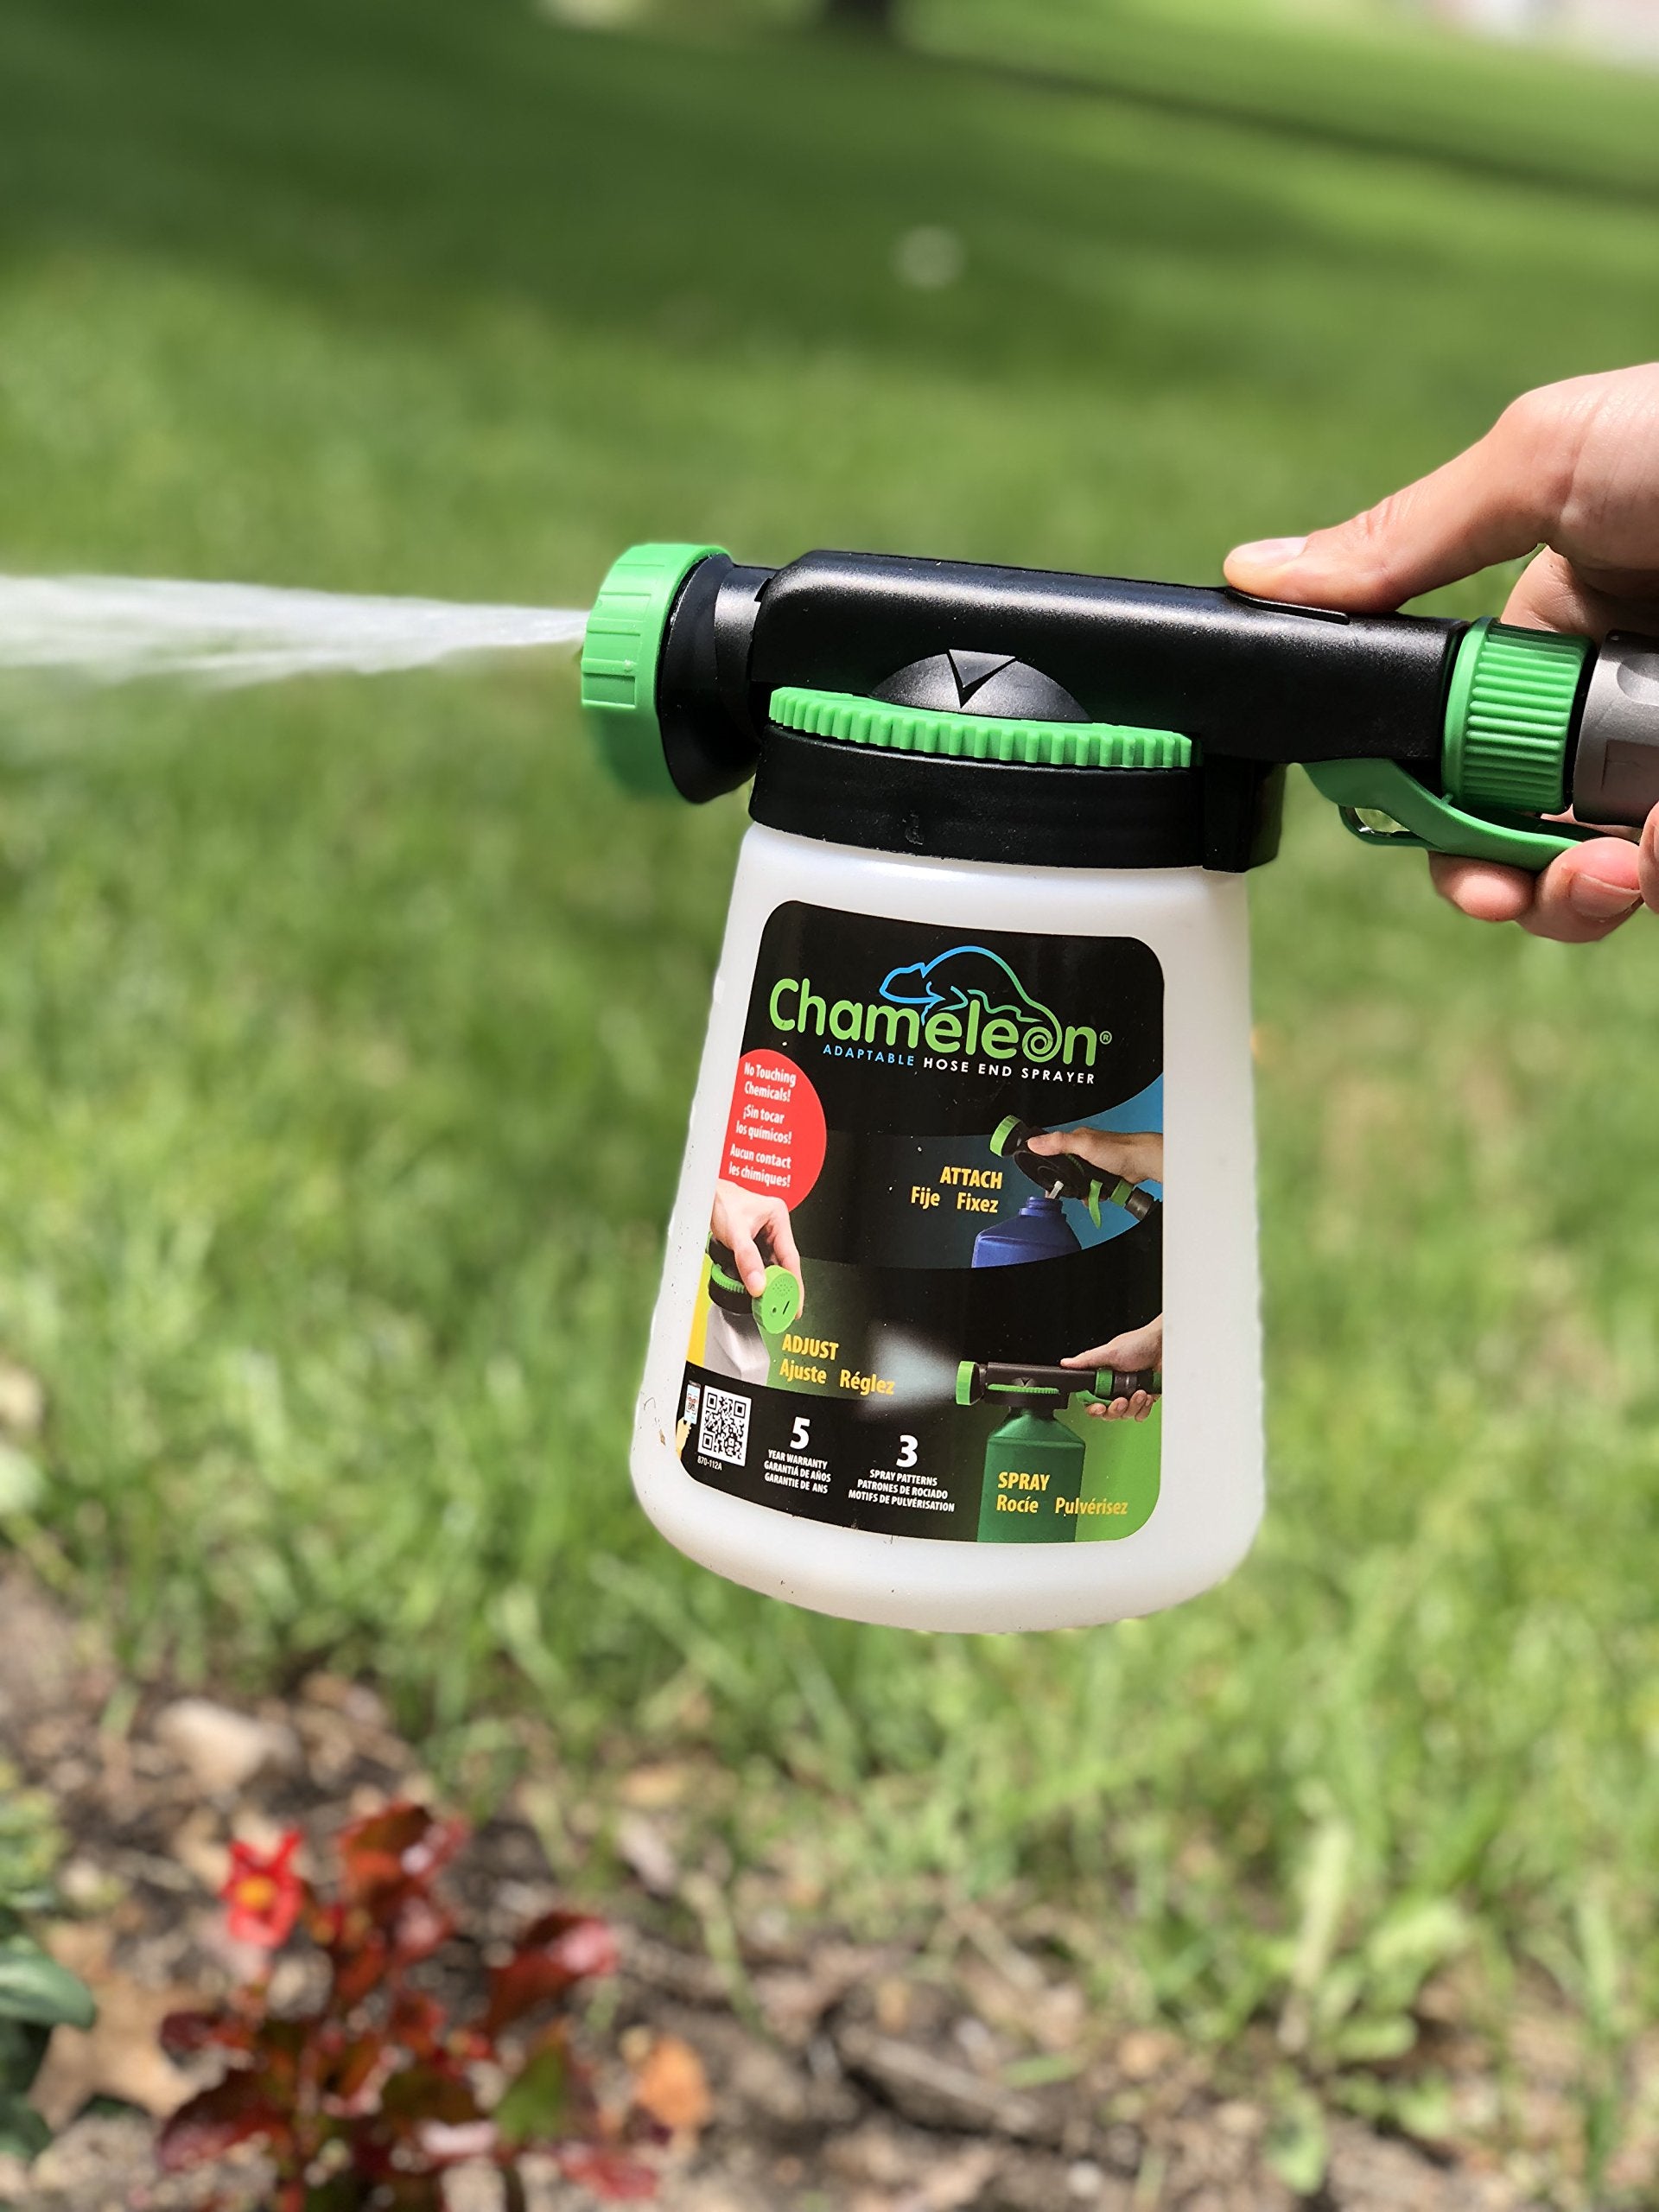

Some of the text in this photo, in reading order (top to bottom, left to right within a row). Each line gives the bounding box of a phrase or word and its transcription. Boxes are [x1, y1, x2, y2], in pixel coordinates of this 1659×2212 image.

[744, 1062, 797, 1088] No Touching
[823, 1044, 1095, 1084] ADAPTABLE HOSE END SPRAYER
[744, 1081, 791, 1103] Chemicals!
[760, 1109, 785, 1124] tocar
[735, 1120, 791, 1144] los químicos!
[730, 1143, 791, 1169] Aucun contact
[728, 1161, 791, 1188] les chimiques!
[939, 1166, 1002, 1189] ATTACH
[911, 1185, 999, 1213] Fije Fixez
[782, 1333, 839, 1360] ADJUST
[779, 1357, 896, 1395] Ajuste Réglez
[790, 1416, 810, 1450] 5
[768, 1449, 828, 1470] YEAR WARRANTY
[896, 1434, 918, 1468] 3
[765, 1471, 828, 1494] GARANTIE DE ANS
[799, 1469, 810, 1478] DE
[810, 1471, 831, 1483] AÑOS
[869, 1469, 938, 1486] SPRAY PATTERNS
[998, 1471, 1050, 1491] SPRAY
[857, 1478, 948, 1499] PATRONES DE ROCIADO
[848, 1490, 955, 1512] MOTIFS DE PULVÉRISATION
[996, 1494, 1128, 1515] Rocíe Pulvérisez
